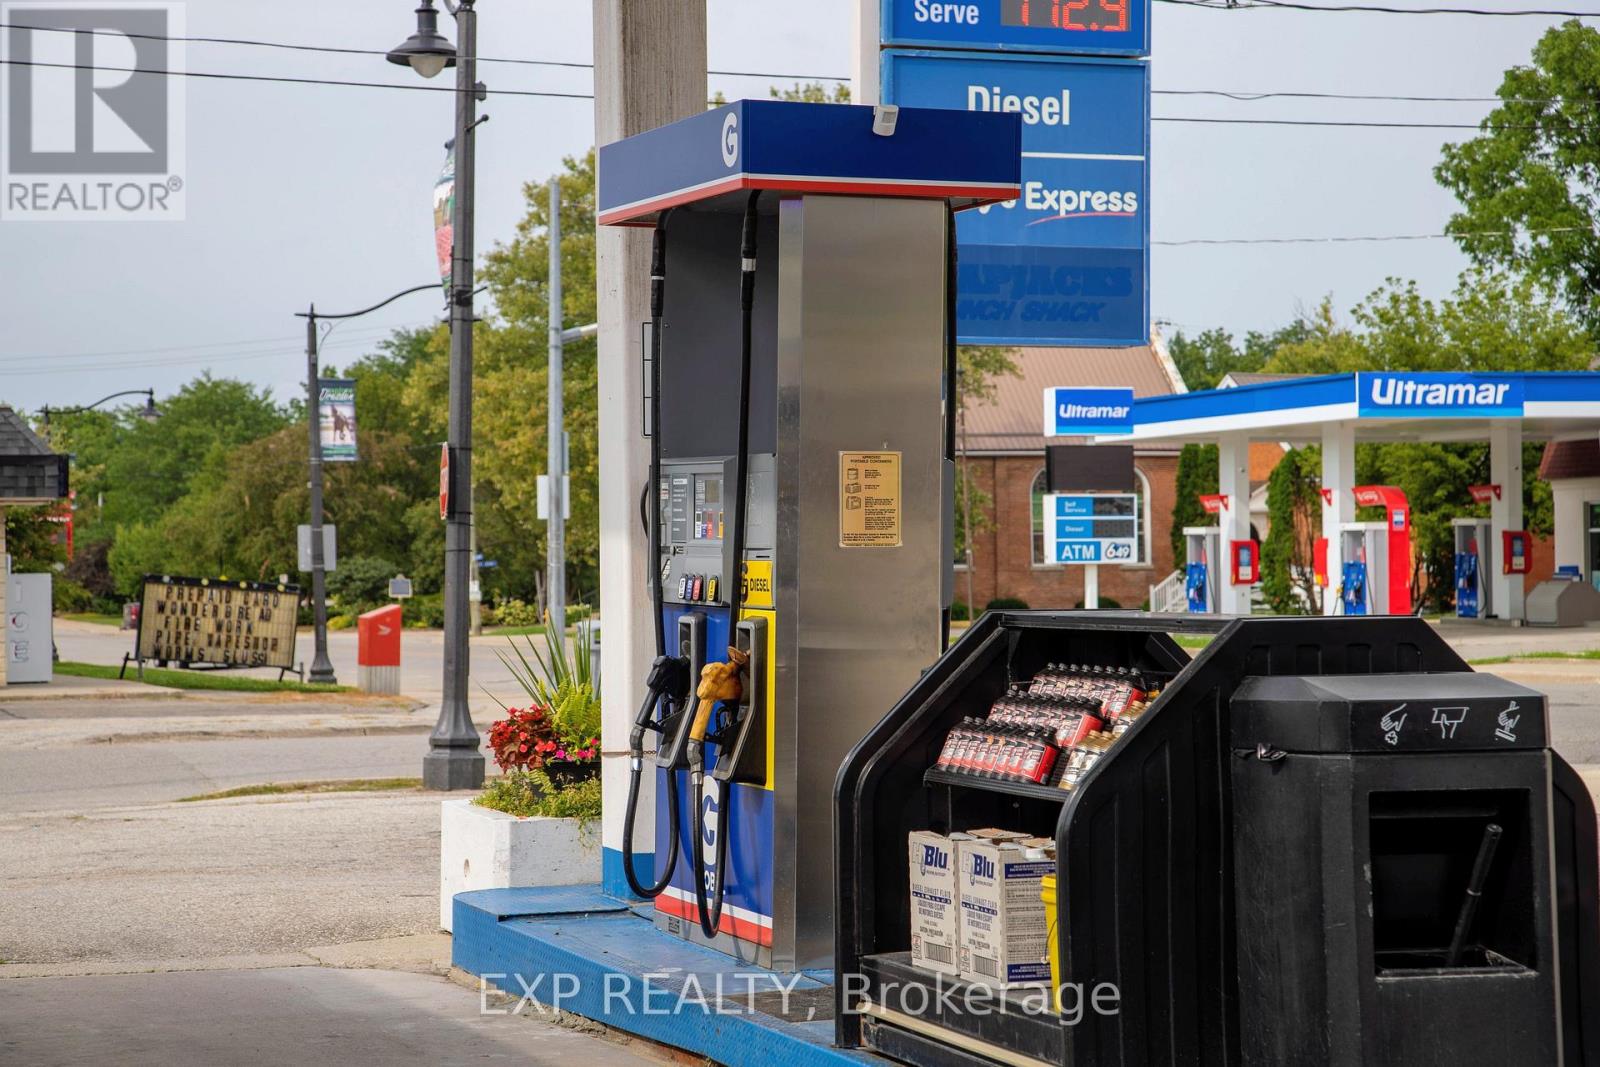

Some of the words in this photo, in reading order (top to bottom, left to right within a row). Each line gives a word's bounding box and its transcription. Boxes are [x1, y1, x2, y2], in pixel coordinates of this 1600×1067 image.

[914, 0, 979, 25] Serve
[1026, 182, 1138, 217] Express
[1371, 378, 1510, 406] Ultramar
[1059, 404, 1130, 419] Ultramar
[1061, 545, 1095, 559] ATM
[750, 578, 770, 592] DIESEL
[166, 586, 232, 604] PREPAID
[243, 592, 279, 608] CARD
[164, 616, 200, 631] FIRE
[215, 619, 253, 635] WORK
